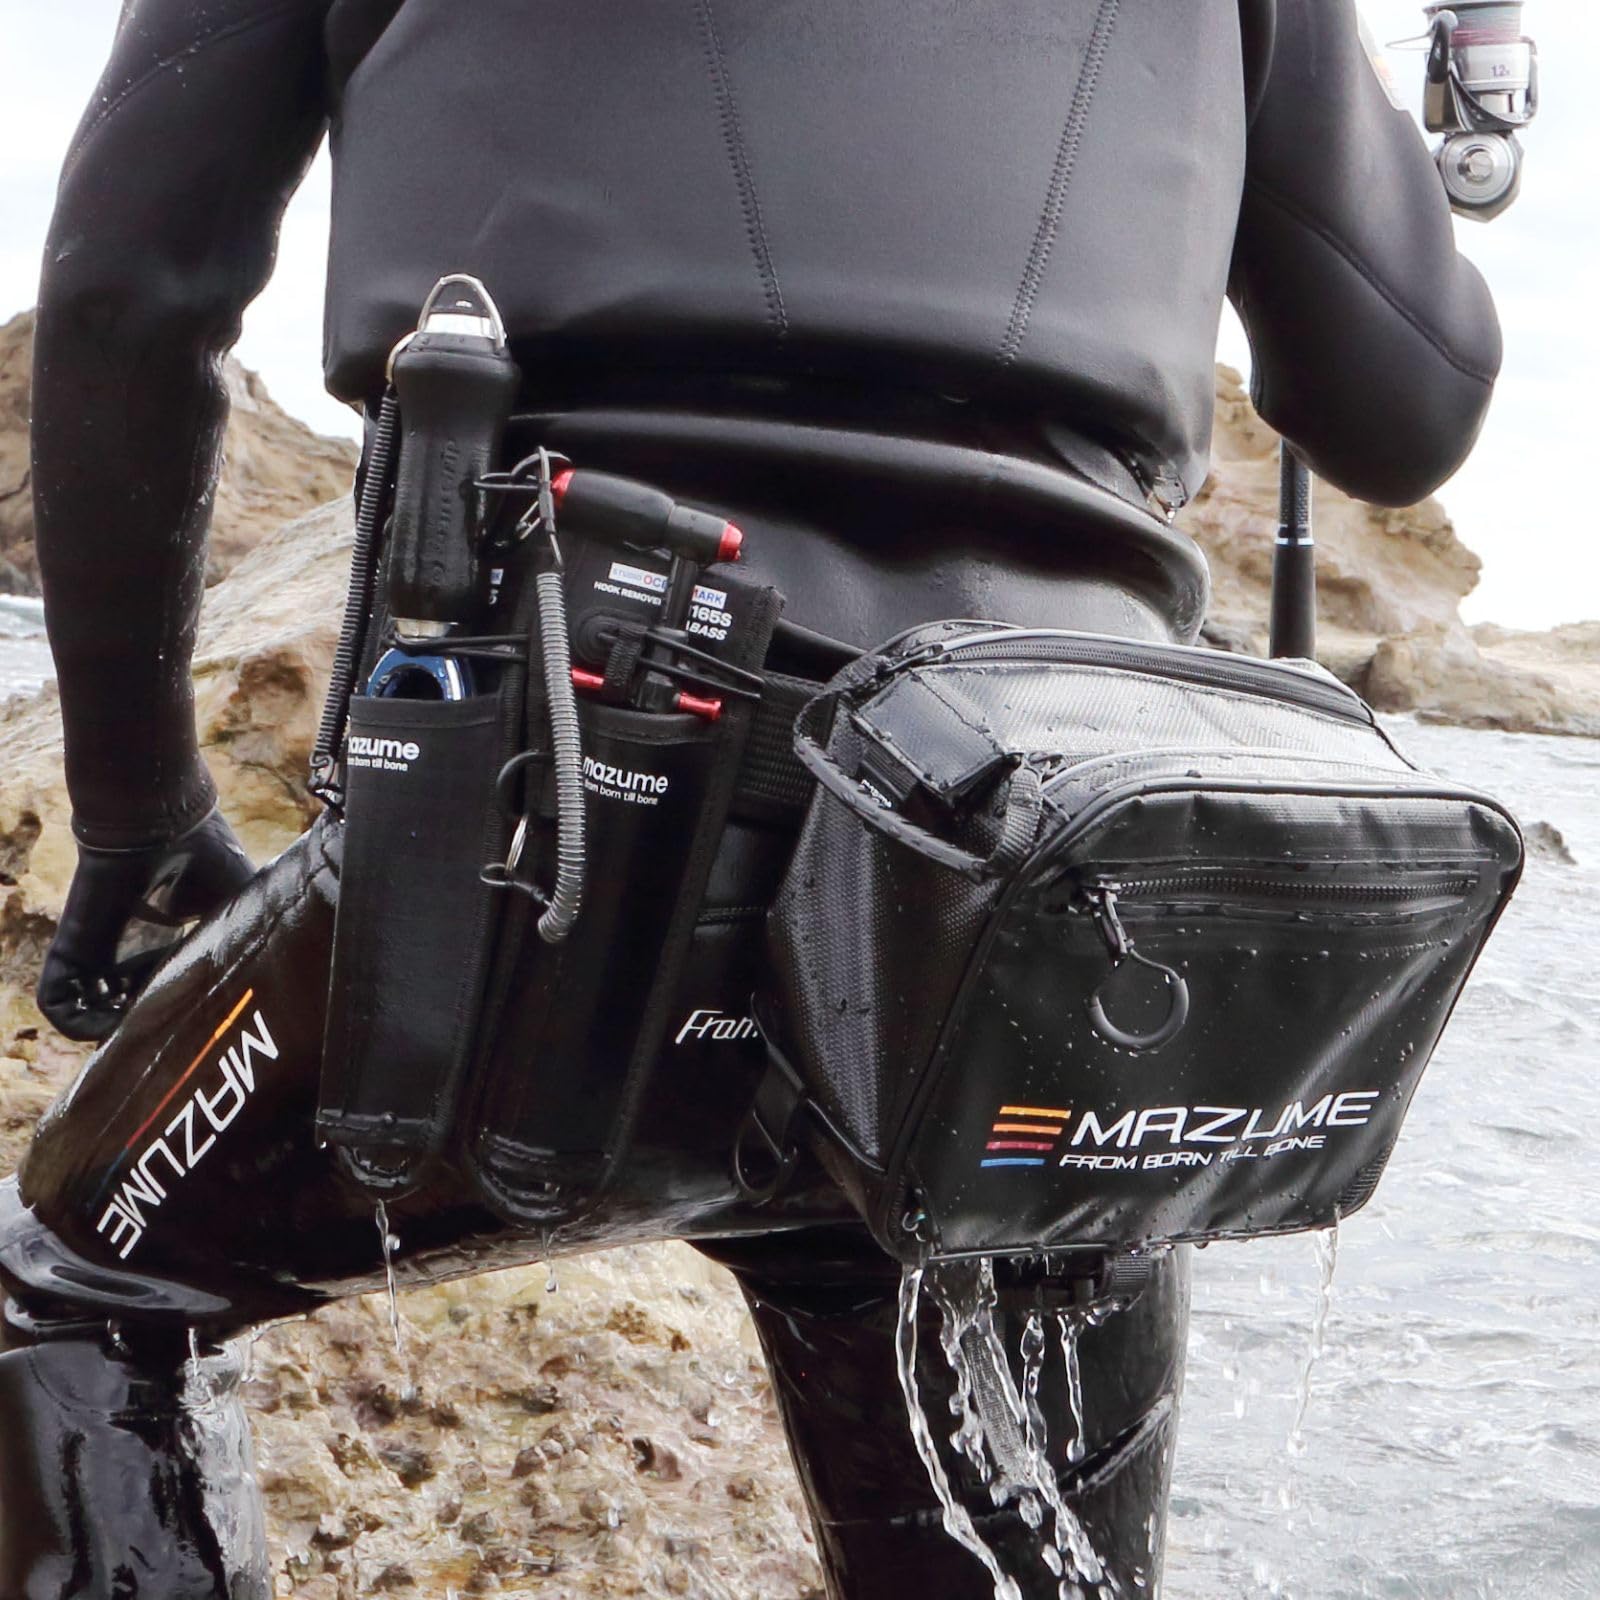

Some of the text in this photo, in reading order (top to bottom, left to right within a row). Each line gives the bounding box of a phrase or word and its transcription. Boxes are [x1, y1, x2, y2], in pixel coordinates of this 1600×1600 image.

[593, 581, 621, 596] HOOK
[643, 575, 668, 590] OCE
[347, 736, 420, 760] azume
[371, 756, 383, 769] till
[383, 758, 408, 772] bone
[583, 756, 669, 794] mazume
[599, 784, 621, 799] born
[623, 792, 636, 803] till
[637, 793, 659, 806] bone
[1070, 1090, 1380, 1148] MAZUME
[96, 1010, 279, 1259] MAZUME
[1059, 1135, 1327, 1171] FROM BORN TILL BONE
